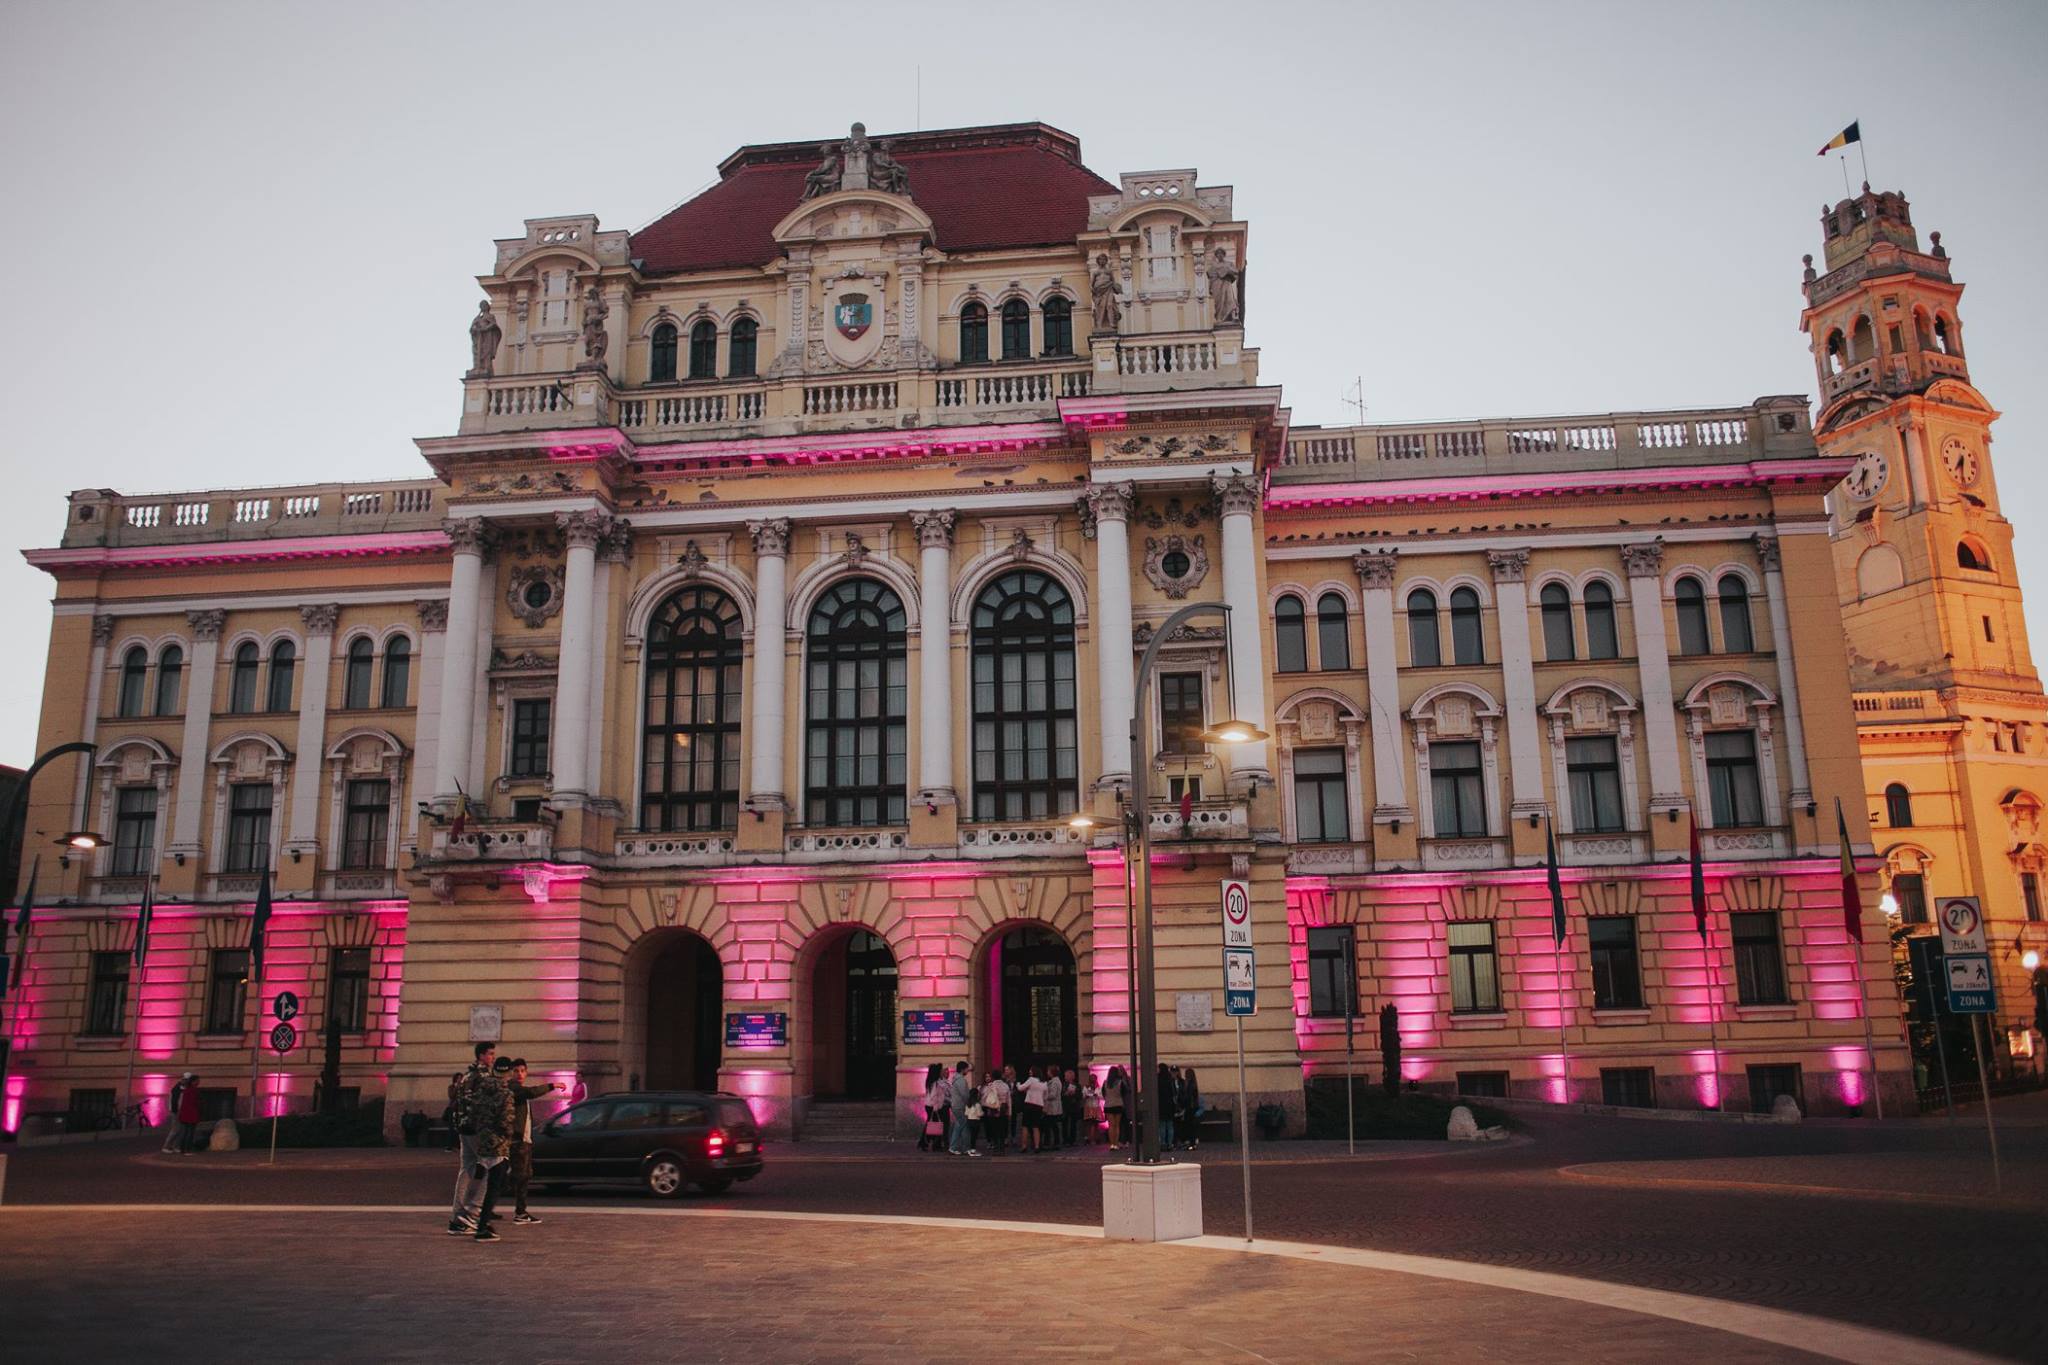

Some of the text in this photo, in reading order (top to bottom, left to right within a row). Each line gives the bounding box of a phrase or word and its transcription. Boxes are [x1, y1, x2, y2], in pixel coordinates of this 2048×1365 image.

[1230, 894, 1243, 914] 20
[1230, 931, 1246, 942] ZONA
[1952, 940, 1976, 950] ZONA
[1233, 996, 1250, 1008] ZONA
[1960, 995, 1985, 1007] ZONA
